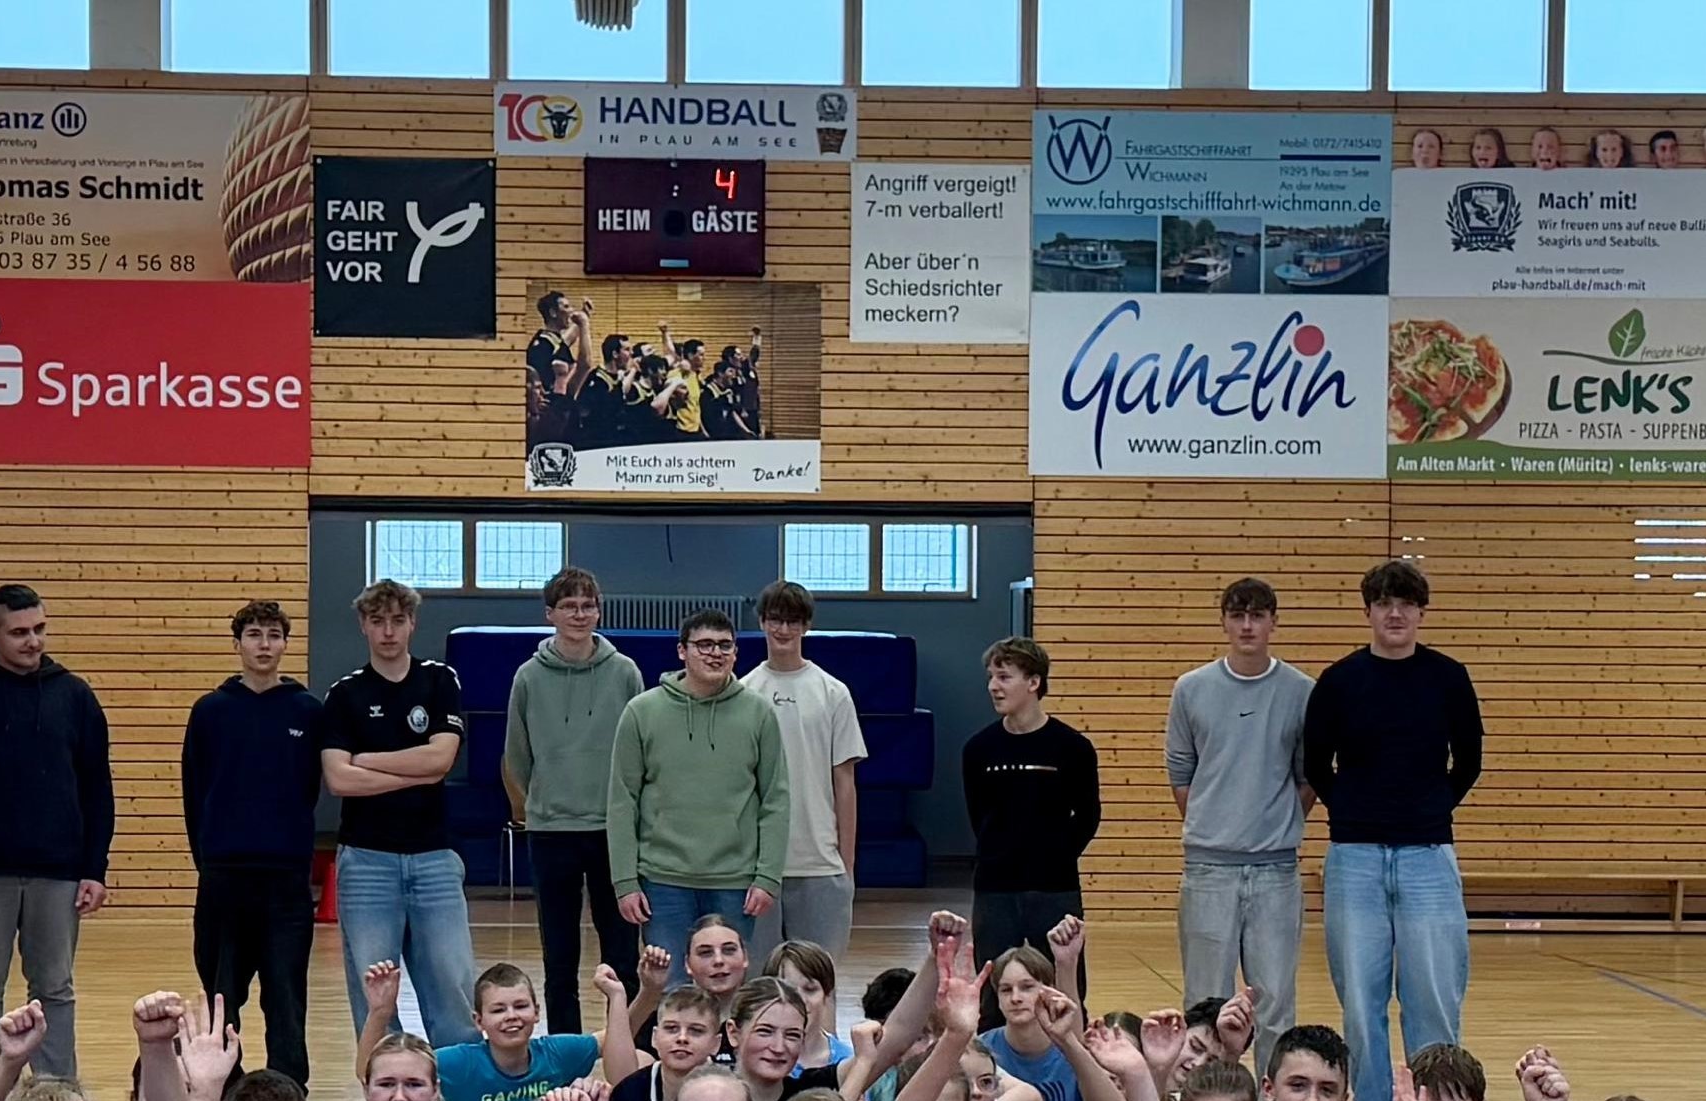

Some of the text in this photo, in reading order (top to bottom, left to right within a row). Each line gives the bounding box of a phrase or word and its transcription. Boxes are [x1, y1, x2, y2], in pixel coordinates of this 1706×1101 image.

[599, 97, 797, 127] HANDBALL
[599, 134, 797, 147] IN PLAU AM SEE
[79, 175, 204, 201] Schmidt
[714, 168, 737, 200] 4
[864, 174, 1017, 196] Angriff vergeigt!
[326, 201, 386, 221] FAIR
[865, 201, 1004, 220] 7-m verballert!
[1046, 190, 1381, 214] www.fahrgastschifffahrt-wichmann.de
[1599, 191, 1637, 210] mit!
[52, 213, 72, 227] 36
[598, 208, 651, 231] HEIM
[692, 205, 758, 233] GÄSTE
[326, 231, 398, 252] GEHT
[326, 261, 383, 282] VOR
[864, 253, 913, 271] Aber
[864, 279, 1003, 297] Schiedsrichter
[864, 305, 960, 324] meckern?
[37, 361, 303, 417] Sparkasse
[1062, 300, 1357, 469] Ganzlin
[1519, 423, 1558, 439] PIZZA
[1579, 423, 1623, 439] PASTA
[1128, 435, 1322, 458] www.ganzlin.com
[606, 454, 736, 469] Mit Euch als achtem
[752, 461, 812, 482] Danke!
[1396, 457, 1418, 471] Am
[1420, 457, 1454, 472] Alten
[1457, 458, 1495, 472] Markt
[1510, 458, 1555, 472] Waren
[1558, 458, 1613, 474] (Müritz)
[615, 471, 719, 486] Mann zum Sieg!
